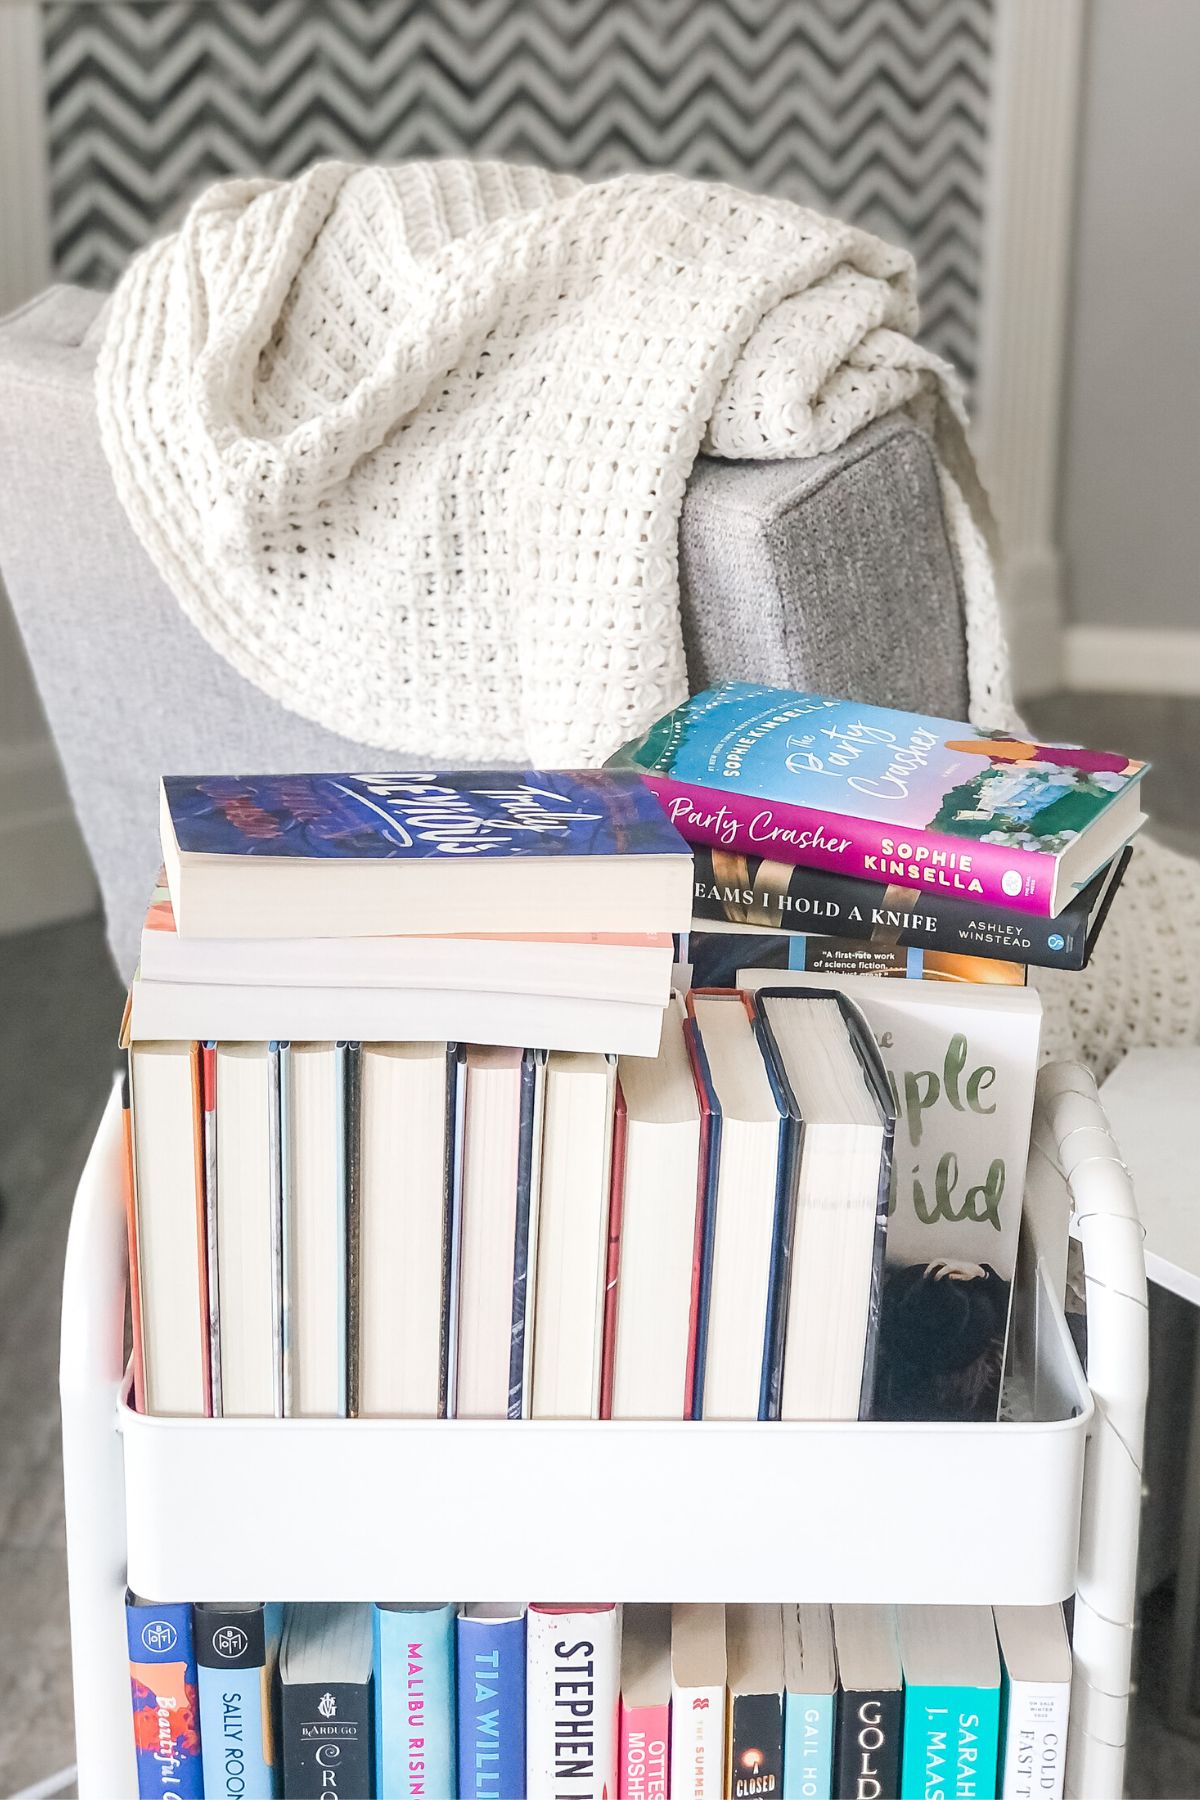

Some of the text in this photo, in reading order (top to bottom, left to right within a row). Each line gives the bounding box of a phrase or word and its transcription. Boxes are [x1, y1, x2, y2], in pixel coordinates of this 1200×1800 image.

[722, 700, 841, 777] SOPHIE KINSELLA
[784, 719, 896, 777] Party
[785, 735, 816, 750] The
[847, 726, 940, 800] Crasher
[349, 773, 514, 854] DEVIOUS
[469, 784, 603, 833] Truly
[667, 796, 853, 854] Party Crasher
[863, 854, 984, 894] KINSELLA
[880, 838, 974, 873] SOPHIE
[694, 882, 938, 933] EAMS I HOLD A KNIFE
[968, 920, 1023, 936] ASHLEY
[813, 960, 823, 968] of
[824, 960, 857, 969] science
[873, 952, 896, 961] work
[958, 930, 1032, 949] WINSTEAD
[888, 1151, 1006, 1232] ild
[474, 1650, 500, 1703] TIA
[222, 1692, 243, 1742] SALLY
[301, 1725, 357, 1738] BARDUGO
[407, 1643, 425, 1800] MALIBU RISIN
[554, 1641, 594, 1778] STEPHEN
[153, 1695, 187, 1785] Beautiful
[802, 1709, 819, 1797] GAIL HO
[856, 1701, 884, 1800] GOLD
[924, 1706, 949, 1800] J. MAAS
[956, 1713, 979, 1798] SARAH
[1017, 1730, 1035, 1778] FAST
[1040, 1733, 1058, 1789] COLD
[736, 1774, 775, 1797] CLOSED
